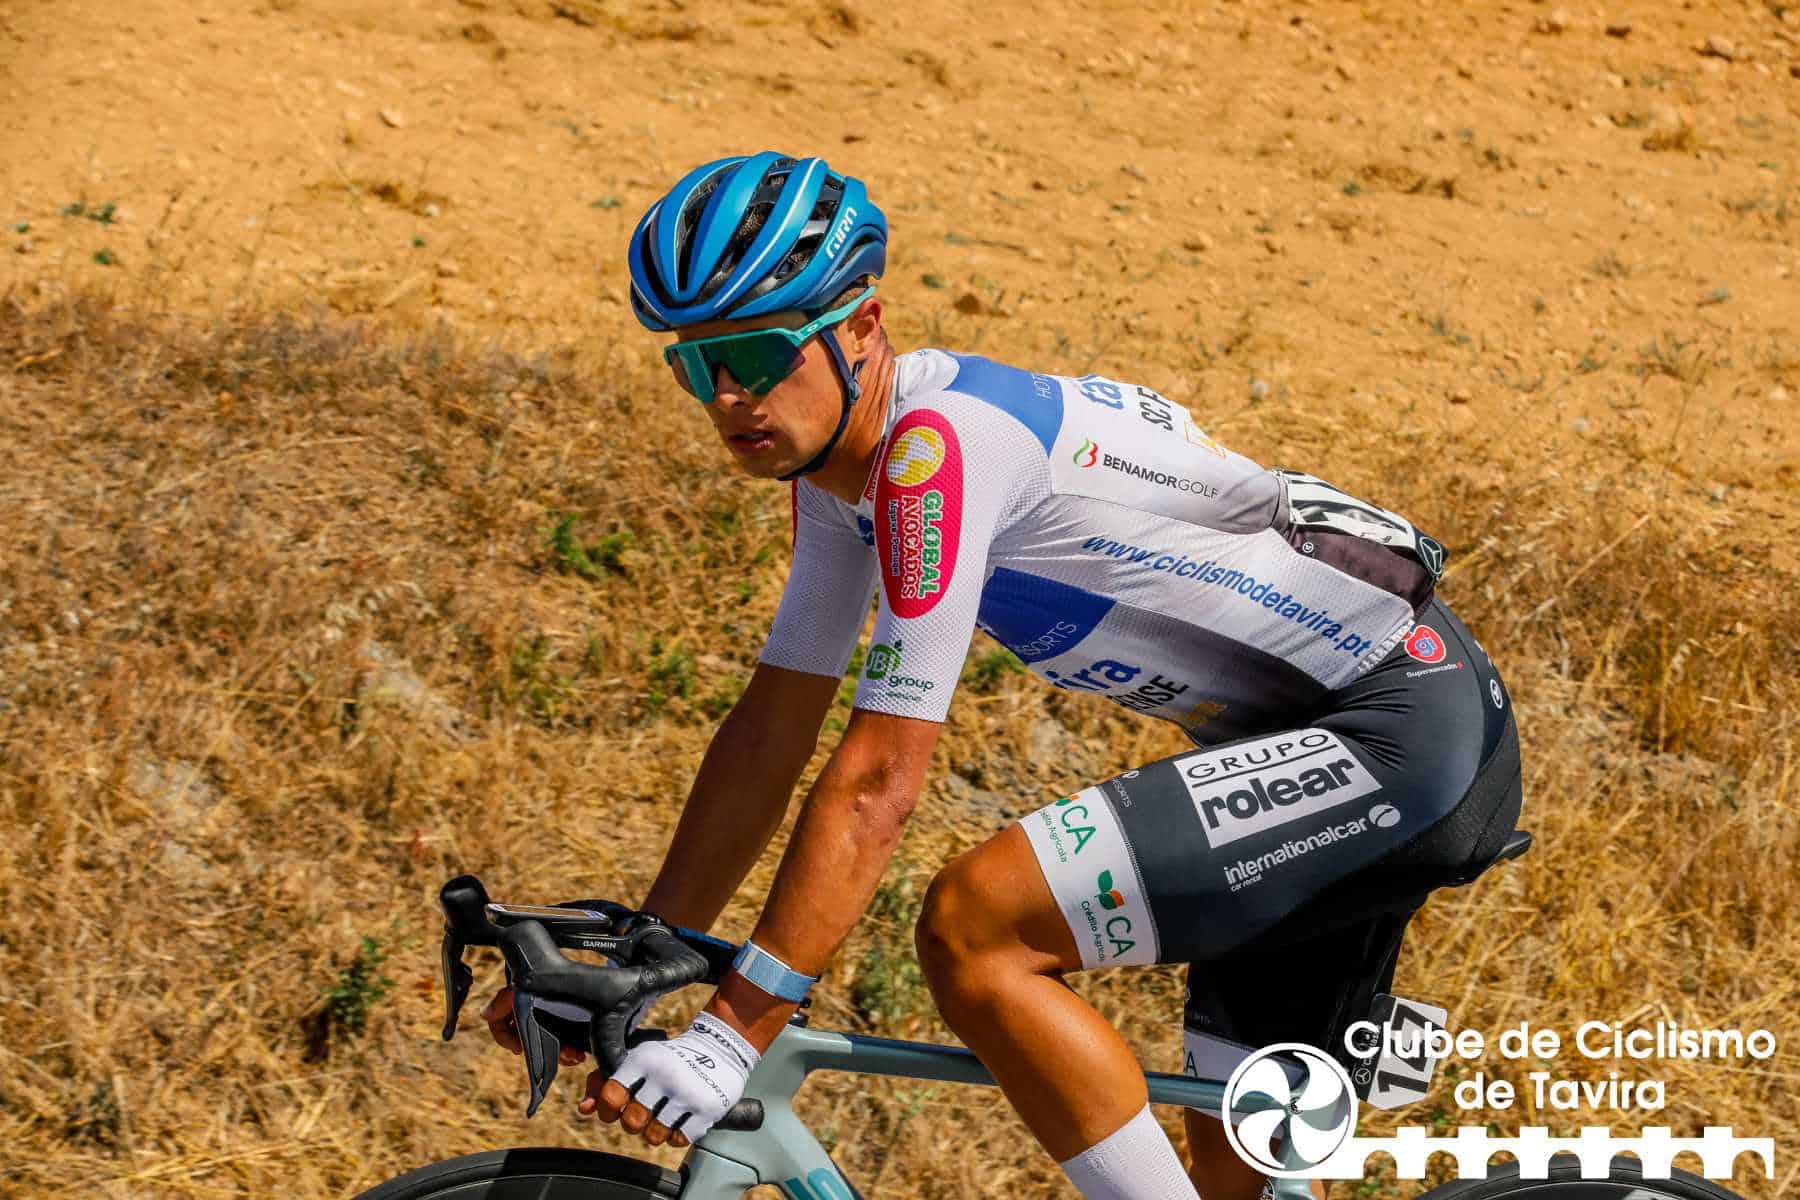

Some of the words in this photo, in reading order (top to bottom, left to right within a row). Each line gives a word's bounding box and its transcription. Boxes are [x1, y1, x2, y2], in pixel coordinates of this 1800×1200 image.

[901, 495, 921, 600] AVOCADOS
[918, 489, 944, 599] GLOBAL
[1082, 535, 1374, 658] www.ciclismodetavira.pt
[888, 675, 935, 692] group
[1186, 734, 1330, 779] GRUPO
[1201, 758, 1356, 830] rolear
[1061, 805, 1096, 855] CA
[1223, 817, 1369, 886] internationalcar
[583, 940, 617, 950] GARMIN
[1106, 916, 1137, 959] CA
